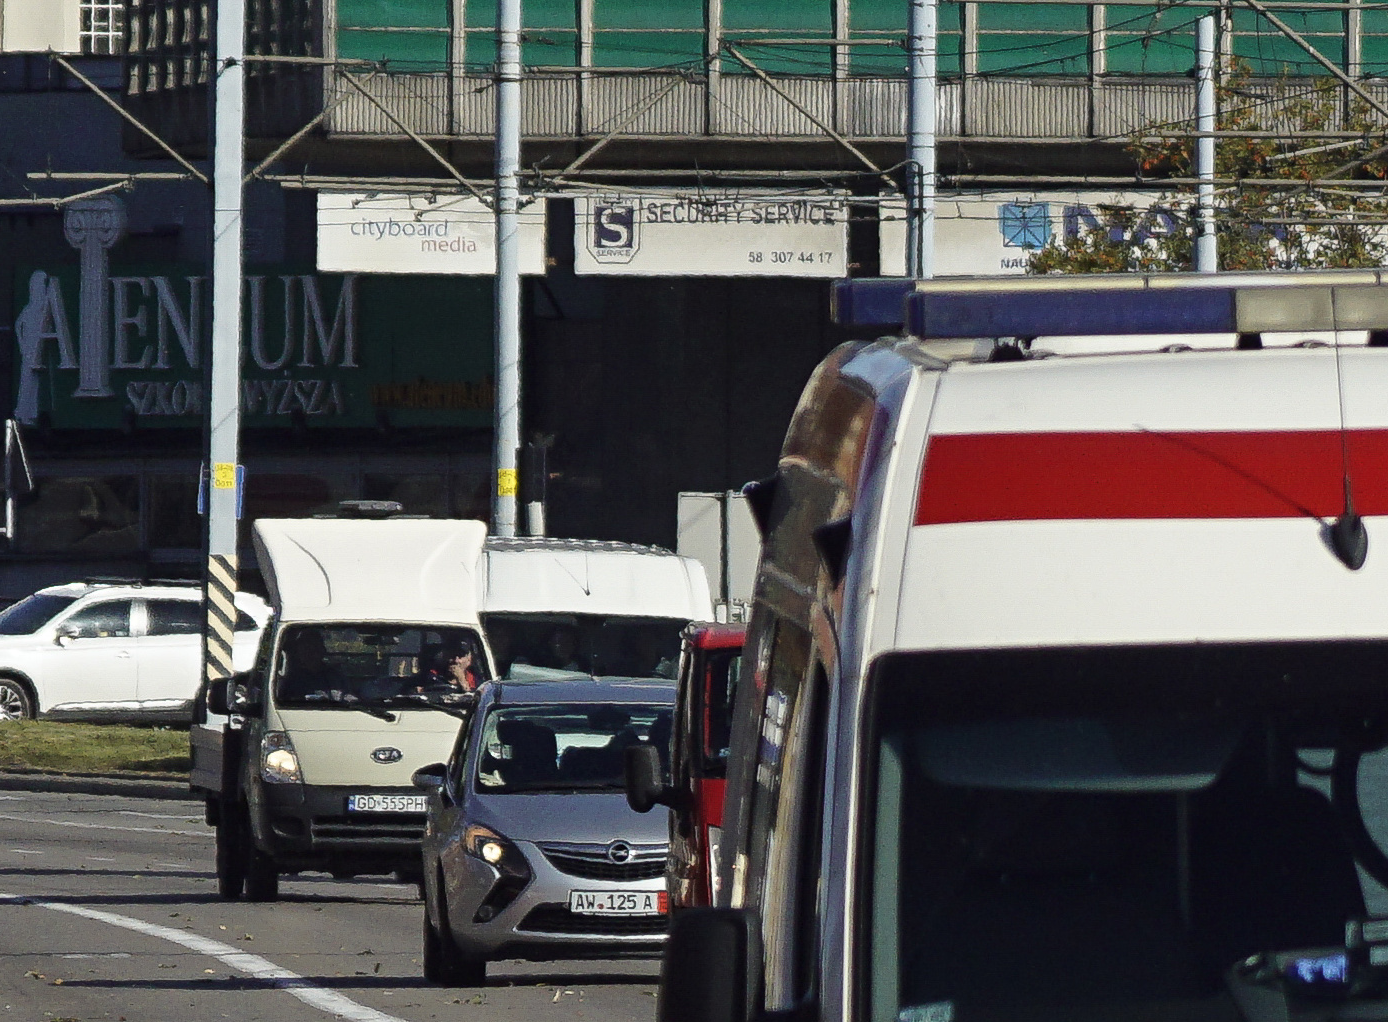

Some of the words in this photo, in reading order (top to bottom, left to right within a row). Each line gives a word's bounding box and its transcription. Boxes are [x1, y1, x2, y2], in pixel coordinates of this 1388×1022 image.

[750, 200, 836, 225] SERVICE
[351, 207, 448, 241] cityboard
[421, 236, 476, 253] media
[748, 251, 764, 263] 58
[770, 251, 794, 263] 307
[797, 251, 815, 263] 44
[818, 251, 833, 263] 17
[16, 270, 359, 396] ATENUM
[126, 380, 212, 416] SZKO
[356, 796, 377, 810] GD
[575, 894, 596, 910] AW
[605, 894, 637, 911] 125
[642, 894, 652, 910] A
